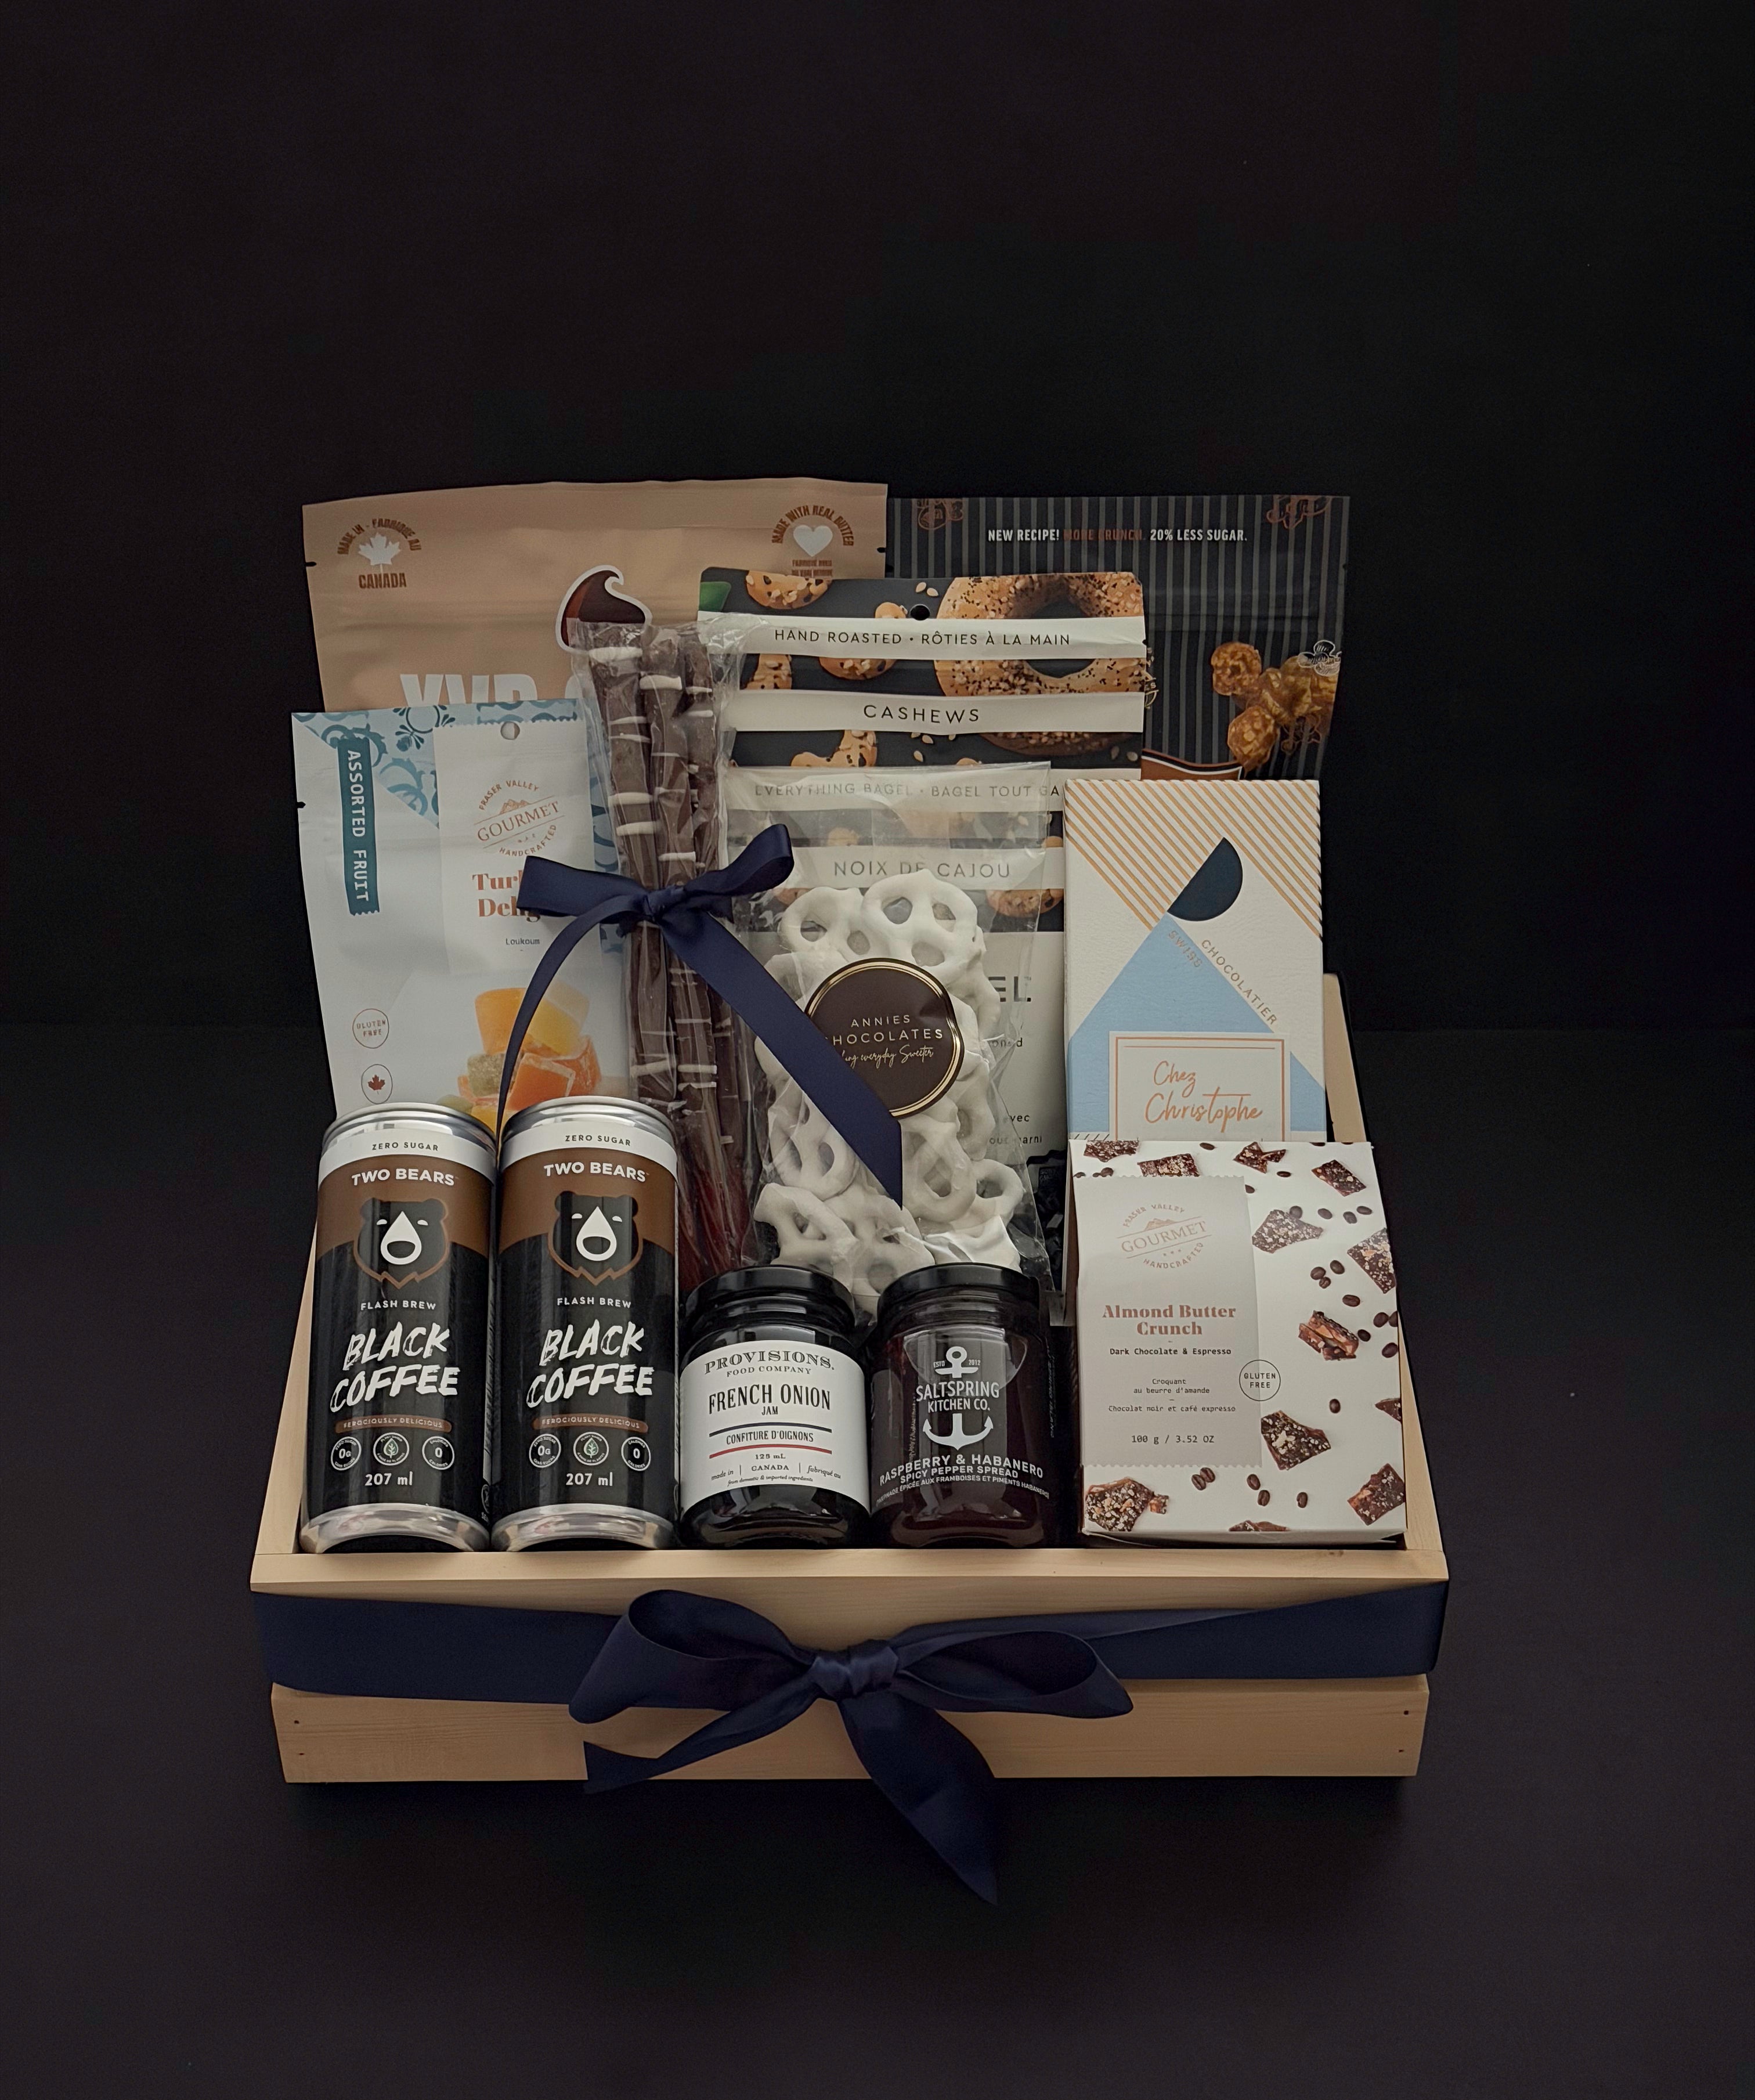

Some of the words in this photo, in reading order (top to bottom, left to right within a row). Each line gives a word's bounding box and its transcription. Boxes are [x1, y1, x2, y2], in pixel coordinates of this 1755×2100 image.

[771, 518, 790, 543] MADE
[785, 505, 810, 522] WITH
[813, 505, 835, 520] REAL
[988, 529, 1013, 541] NEW
[1017, 529, 1059, 541] RECIPE!
[1150, 529, 1173, 541] 20%
[1177, 529, 1203, 541] LESS
[1207, 529, 1247, 541] SUGAR.
[359, 573, 407, 589] CANADA
[775, 630, 819, 642] HAND
[828, 632, 902, 644] ROASTED
[922, 631, 978, 645] RÔTIES
[985, 631, 995, 645] À
[1003, 635, 1021, 645] LA
[1030, 634, 1070, 645] MAIN
[864, 705, 980, 724] CASHEWS
[348, 750, 366, 837] ASSORTED
[479, 784, 502, 810] FRASER
[506, 780, 539, 791] VALLEY
[755, 783, 855, 796] EVERYTHING
[864, 783, 913, 796] BAGEL
[931, 785, 981, 797] BAGEL
[989, 785, 1030, 796] TOUT
[478, 800, 559, 842] GOURMET
[499, 824, 557, 857] HANDCRAFTED
[353, 850, 369, 901] FRUIT
[834, 861, 887, 876] NOIX
[900, 861, 925, 875] DE
[937, 863, 1010, 877] CAJOU
[1168, 930, 1201, 969] SWISS
[1201, 940, 1278, 1025] CHOCOLATIER
[851, 1015, 910, 1027] ANNIES
[825, 1029, 943, 1045] HOCOLATES
[861, 1047, 897, 1069] everyday
[900, 1044, 933, 1063] Sweeter
[1153, 1060, 1197, 1098] Chez
[1144, 1086, 1263, 1133] Christophe
[372, 1142, 398, 1150] ZERO
[404, 1142, 438, 1151] SUGAR
[598, 1135, 631, 1146] SUGAR
[351, 1168, 391, 1186] TWO
[395, 1168, 455, 1186] BEARS
[544, 1161, 584, 1177] TWO
[590, 1162, 646, 1182] BEARS
[1123, 1207, 1146, 1227] FRASER
[1151, 1204, 1185, 1213] VALLEY
[1121, 1221, 1206, 1253] GOURMET
[1143, 1242, 1204, 1269] HANDCRAFTED
[360, 1300, 398, 1311] FLASH
[403, 1300, 436, 1310] BREW
[557, 1296, 594, 1306] FLASH
[600, 1297, 631, 1309] BREW
[1102, 1305, 1173, 1318] Almond
[1179, 1305, 1236, 1318] Butter
[1137, 1322, 1202, 1336] Crunch
[342, 1321, 450, 1370] BLACK
[539, 1319, 644, 1366] BLACK
[1193, 1348, 1232, 1356] Espresso
[727, 1367, 754, 1377] FOOD
[759, 1366, 812, 1374] COMPANY
[329, 1363, 461, 1413] COFFEE
[526, 1363, 655, 1408] COFFEE
[916, 1380, 1000, 1402] SALTSPRING
[709, 1384, 772, 1415] FRENCH
[781, 1384, 830, 1410] ONION
[928, 1398, 970, 1413] KITCHEN
[974, 1398, 990, 1411] CO.
[761, 1406, 778, 1415] JAM
[400, 1417, 443, 1428] DELICIOUS
[541, 1417, 596, 1426] FEROCIOUSLY
[599, 1417, 640, 1428] DELICIOUS
[726, 1430, 768, 1445] CONFITURE
[771, 1430, 814, 1442] D'OIGNONS
[1132, 1435, 1148, 1443] 100
[1154, 1437, 1159, 1445] g
[1176, 1435, 1198, 1443] 3.52
[1203, 1435, 1214, 1443] OZ
[364, 1473, 392, 1486] 207
[398, 1471, 413, 1486] ml
[566, 1473, 593, 1486] 207
[598, 1471, 613, 1486] ml
[806, 1465, 833, 1477] fabriqué
[880, 1455, 951, 1486] RASPBERRY
[956, 1454, 965, 1464] &
[972, 1454, 1043, 1478] HABANERO
[900, 1470, 927, 1484] SPICY
[931, 1466, 973, 1475] PEPPER
[977, 1466, 1018, 1478] SPREAD
[920, 1477, 935, 1485] AUX
[992, 1477, 1020, 1487] PIMENTS
